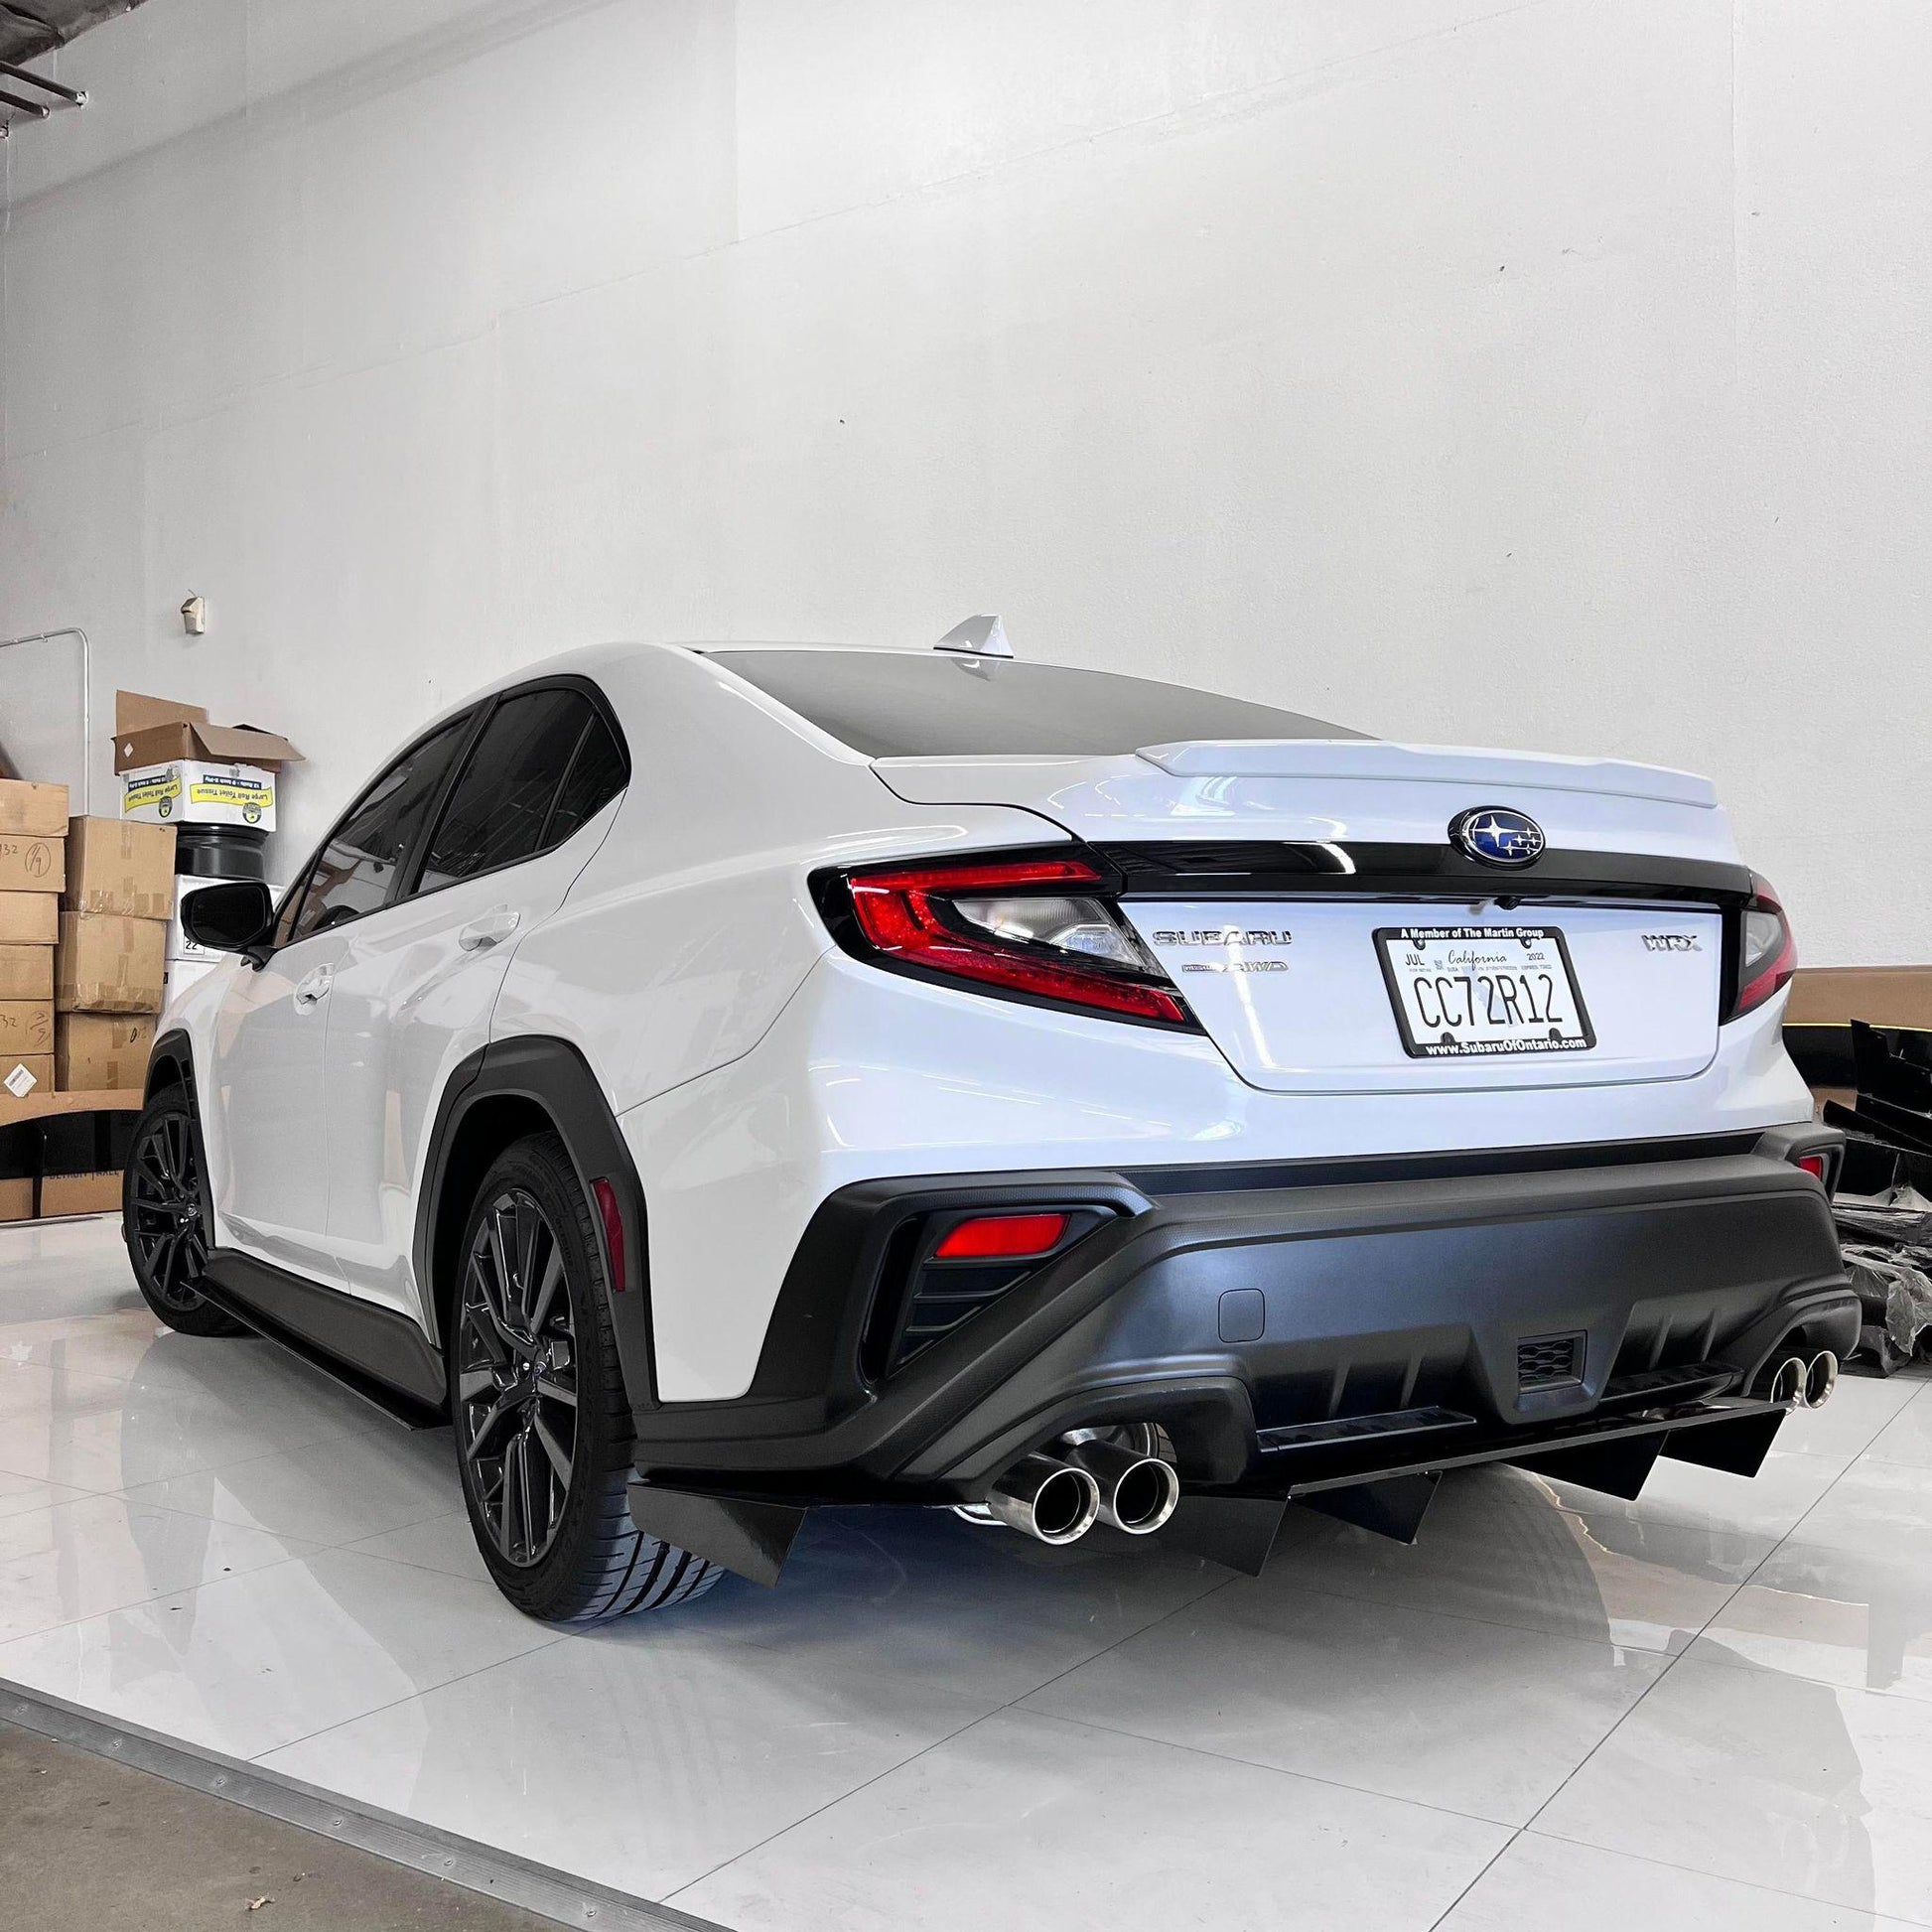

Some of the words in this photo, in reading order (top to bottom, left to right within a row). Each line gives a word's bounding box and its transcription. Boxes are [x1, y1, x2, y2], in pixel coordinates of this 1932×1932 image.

[164, 783, 178, 793] Large
[218, 789, 236, 799] Toilet
[128, 793, 142, 802] Tissue
[0, 844, 18, 855] 32
[1153, 930, 1293, 946] SUBARU
[1401, 928, 1409, 939] A
[1410, 927, 1450, 939] Member
[1451, 927, 1462, 938] of
[1462, 927, 1482, 938] The
[1483, 926, 1515, 938] Martin
[1515, 927, 1545, 939] Group
[1640, 934, 1704, 952] WRX
[1405, 953, 1426, 966] JUL
[1448, 949, 1508, 971] California
[1525, 952, 1546, 961] 2022
[1413, 973, 1564, 1029] CC72R12
[1426, 1037, 1587, 1055] www.SubaruOfOntario.com
